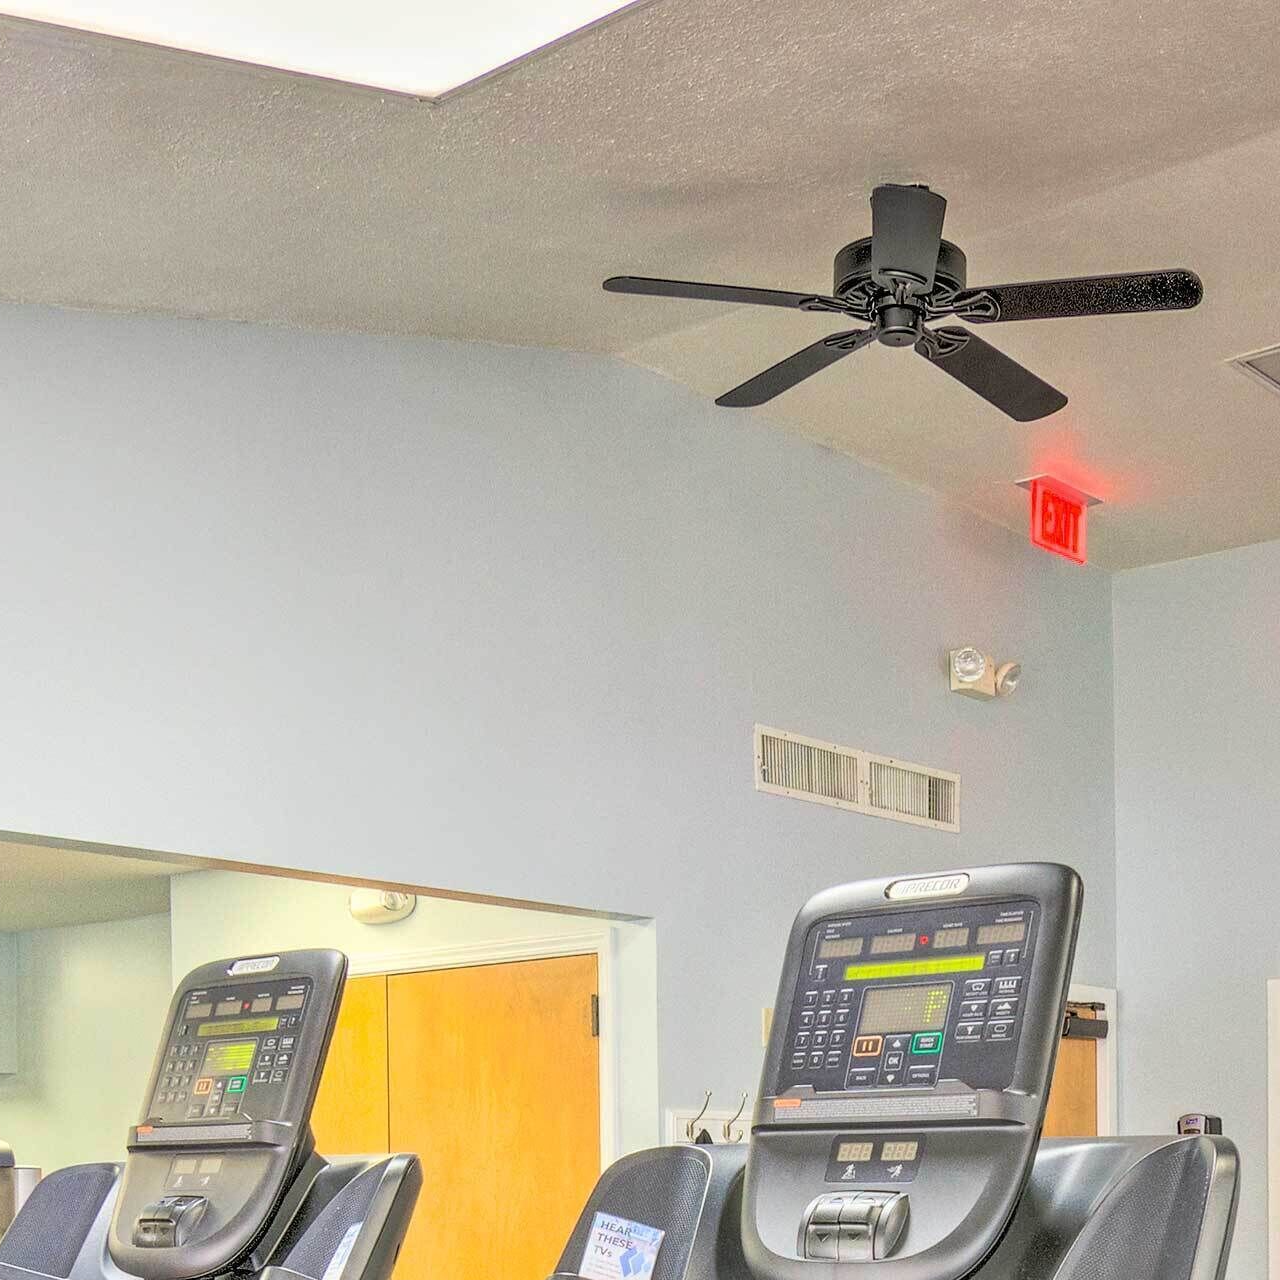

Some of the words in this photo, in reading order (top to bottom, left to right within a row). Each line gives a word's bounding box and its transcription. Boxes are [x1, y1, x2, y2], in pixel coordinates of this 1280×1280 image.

[1042, 489, 1081, 552] EXIT
[887, 1056, 899, 1065] OK
[600, 1220, 633, 1237] HEAR
[597, 1232, 633, 1250] THESE
[593, 1245, 613, 1258] TVs
